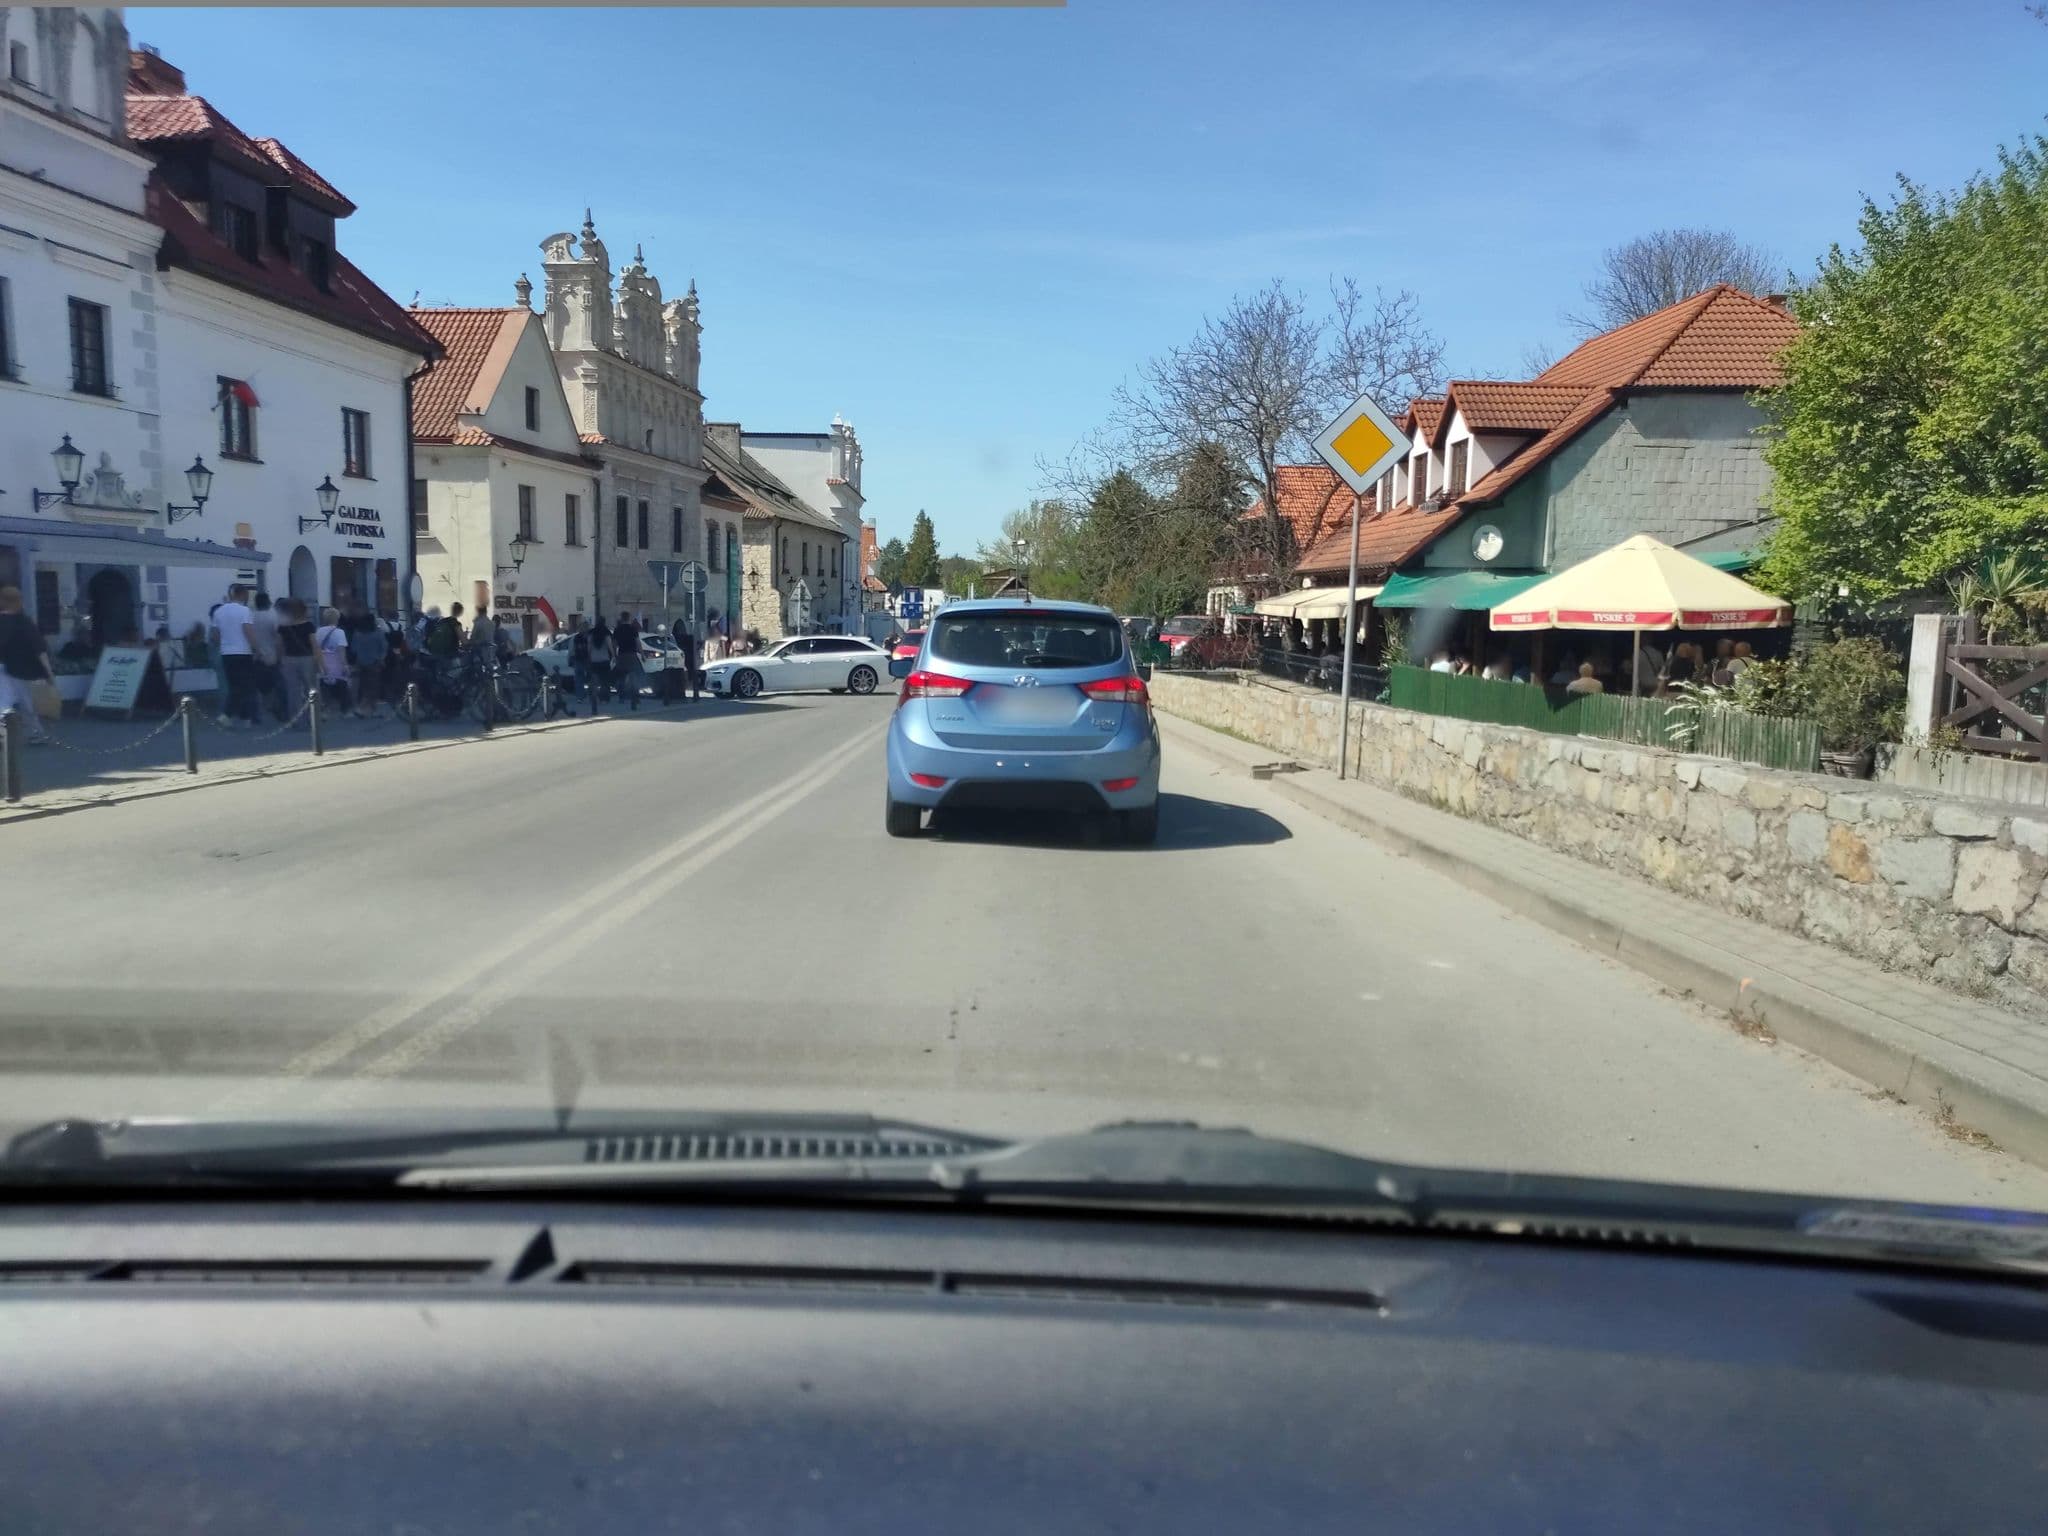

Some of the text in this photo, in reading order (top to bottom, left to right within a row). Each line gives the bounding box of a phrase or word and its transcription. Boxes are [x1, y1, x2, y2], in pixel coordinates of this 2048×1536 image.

[338, 505, 381, 521] GALERIA
[335, 522, 385, 539] AUTORSKA
[1592, 612, 1625, 623] TYSKIE
